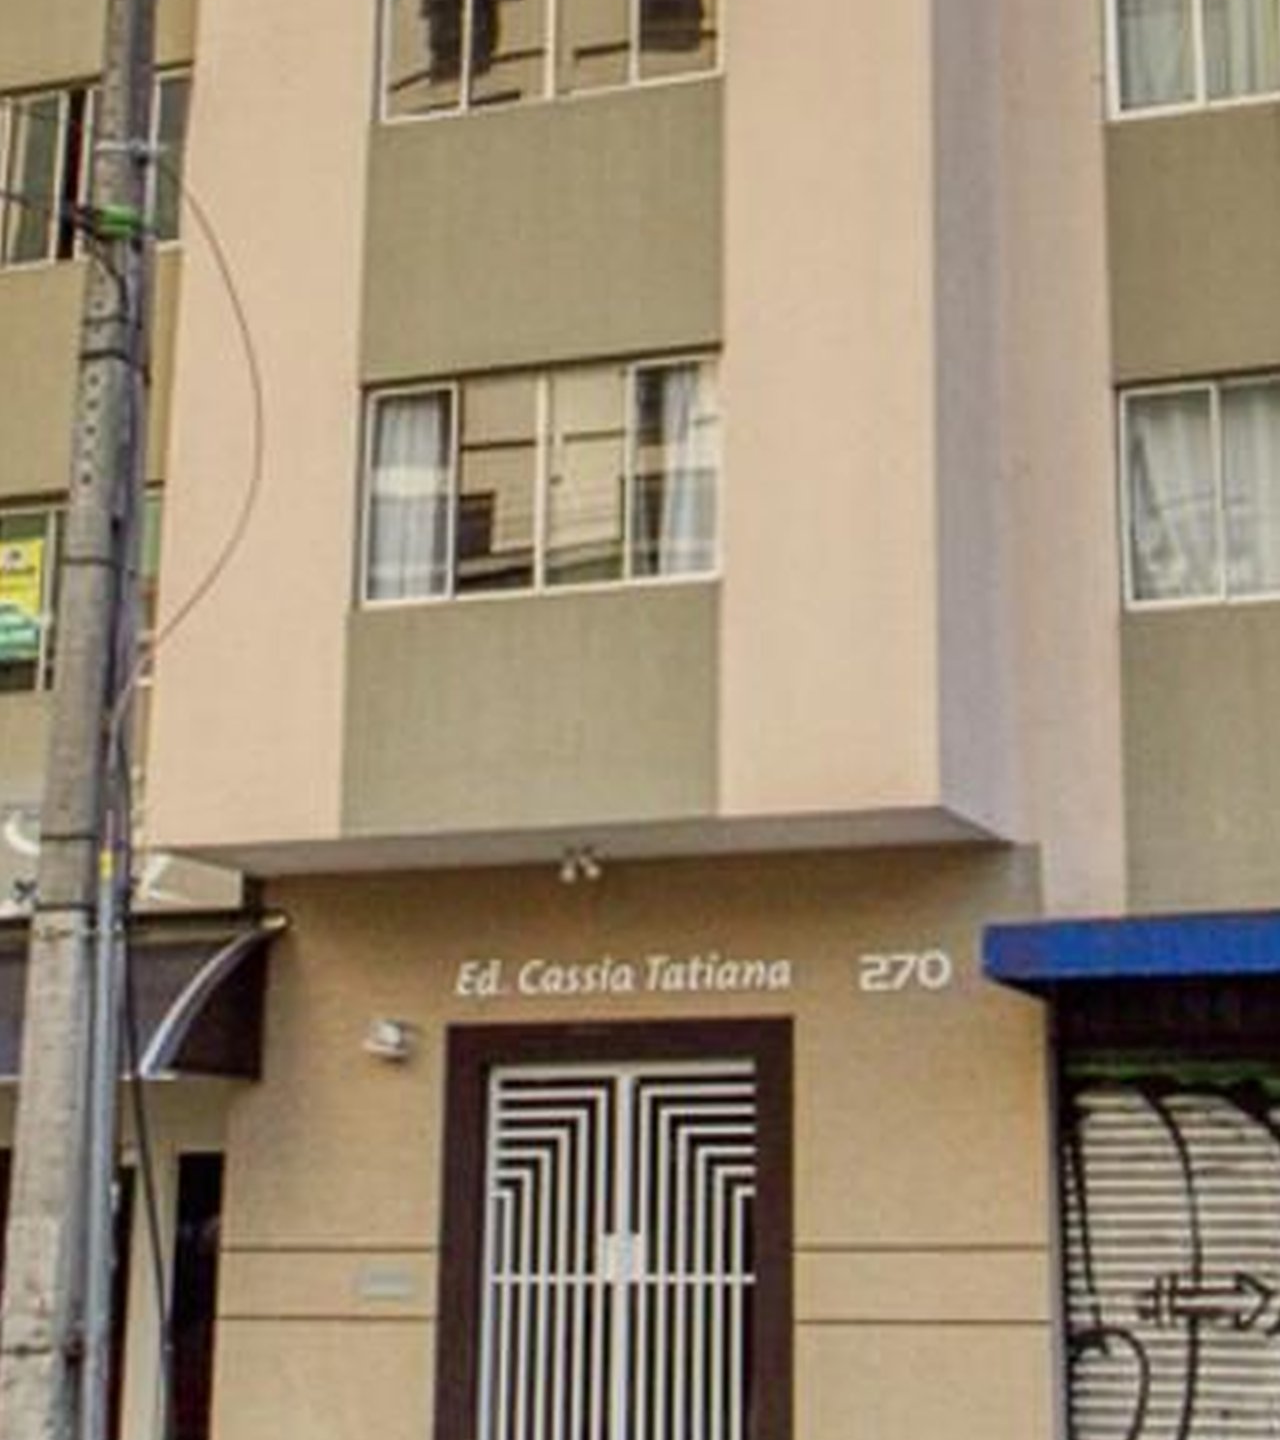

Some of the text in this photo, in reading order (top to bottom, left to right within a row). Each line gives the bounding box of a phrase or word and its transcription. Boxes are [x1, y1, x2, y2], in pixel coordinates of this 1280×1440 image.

[520, 956, 634, 994] Cassia
[646, 954, 792, 990] Tatiana
[859, 952, 951, 991] 270
